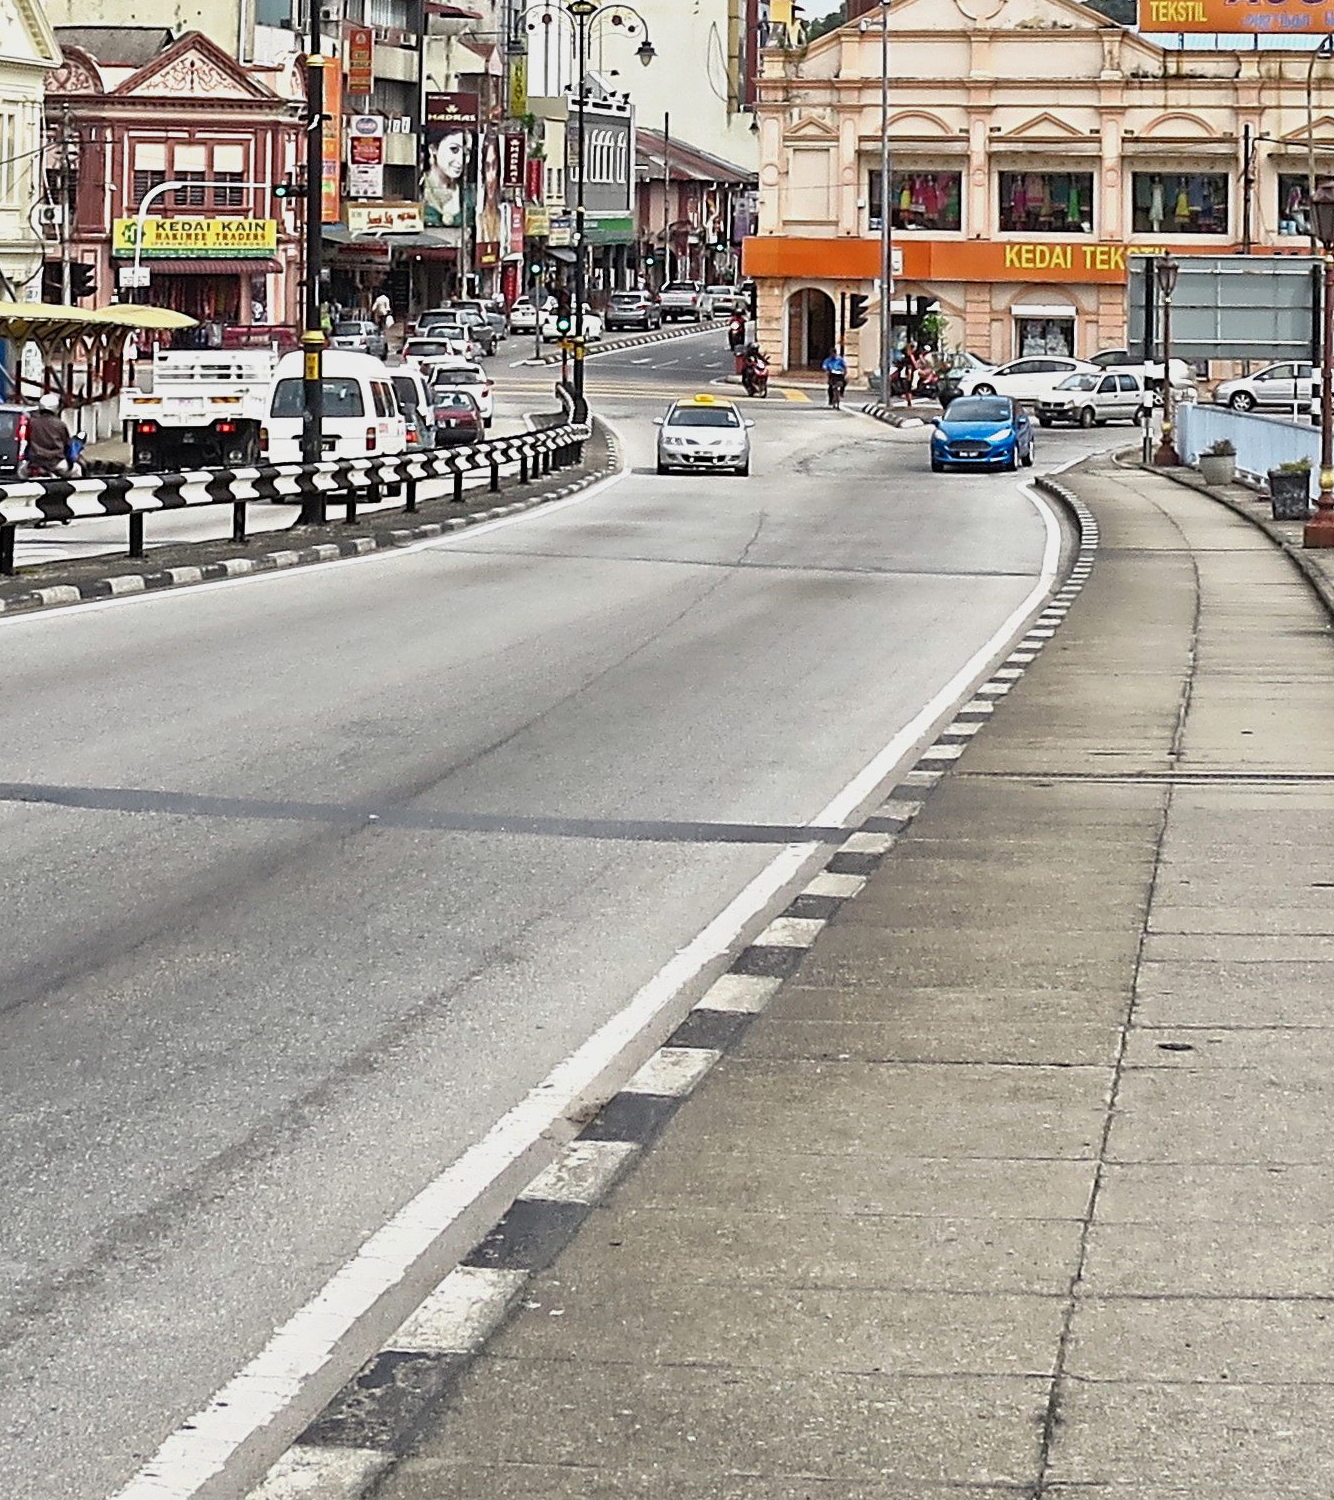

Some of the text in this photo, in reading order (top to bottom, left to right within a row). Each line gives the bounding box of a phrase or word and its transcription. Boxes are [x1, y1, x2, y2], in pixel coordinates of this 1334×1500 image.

[1150, 1, 1208, 23] TEKSTIL
[427, 113, 477, 122] MADRAS
[155, 222, 266, 232] KEDAI KAIN
[215, 232, 266, 241] TRADERS
[1004, 244, 1072, 269] KEDAI
